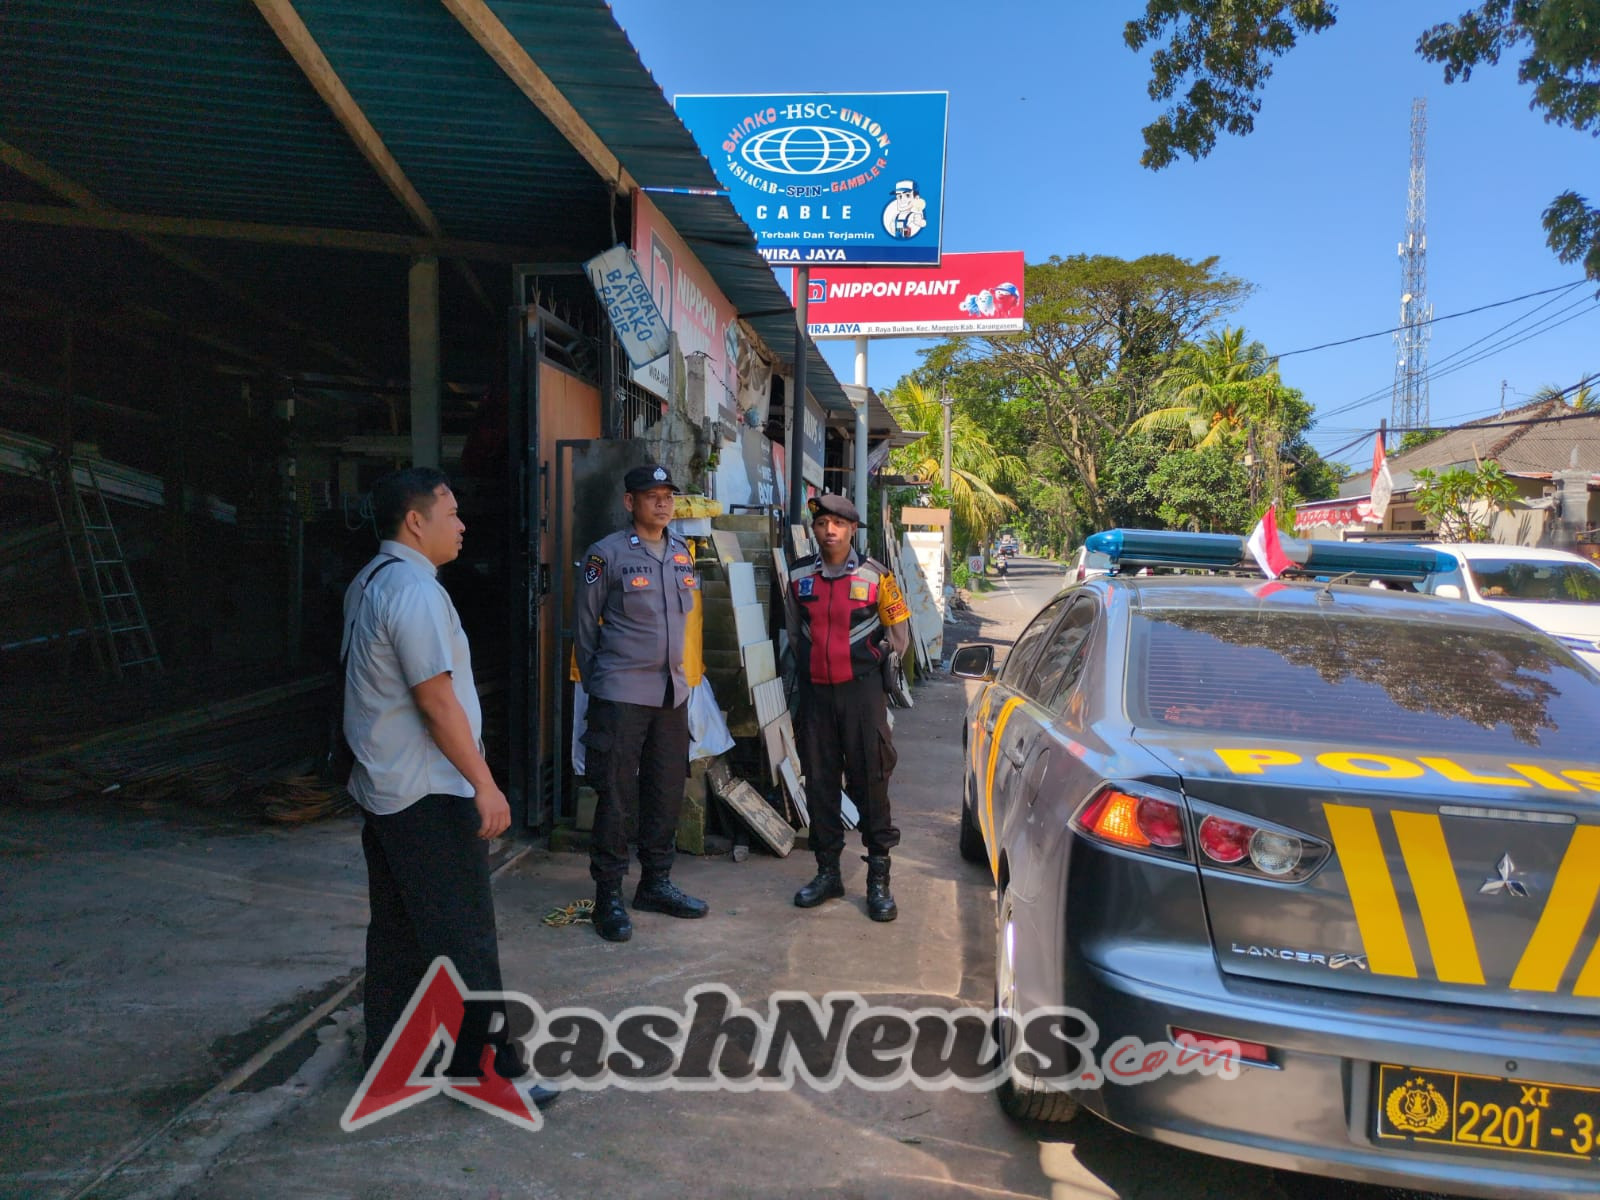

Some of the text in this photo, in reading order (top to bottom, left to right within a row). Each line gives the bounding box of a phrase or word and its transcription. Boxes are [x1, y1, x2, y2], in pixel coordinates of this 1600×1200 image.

[839, 107, 891, 149] UNION
[761, 231, 800, 239] Terbaik
[803, 231, 824, 239] Dan
[828, 231, 875, 241] Terjamin
[759, 249, 847, 261] WIRA JAYA
[626, 272, 657, 326] KORAL
[677, 267, 717, 337] NIPPON
[829, 279, 960, 299] NIPPON PAINT
[599, 286, 630, 336] PASIR
[606, 269, 652, 342] BATAKO
[832, 323, 861, 334] JAYA
[1231, 943, 1367, 970] LANCER EX
[1520, 1085, 1550, 1107] XI
